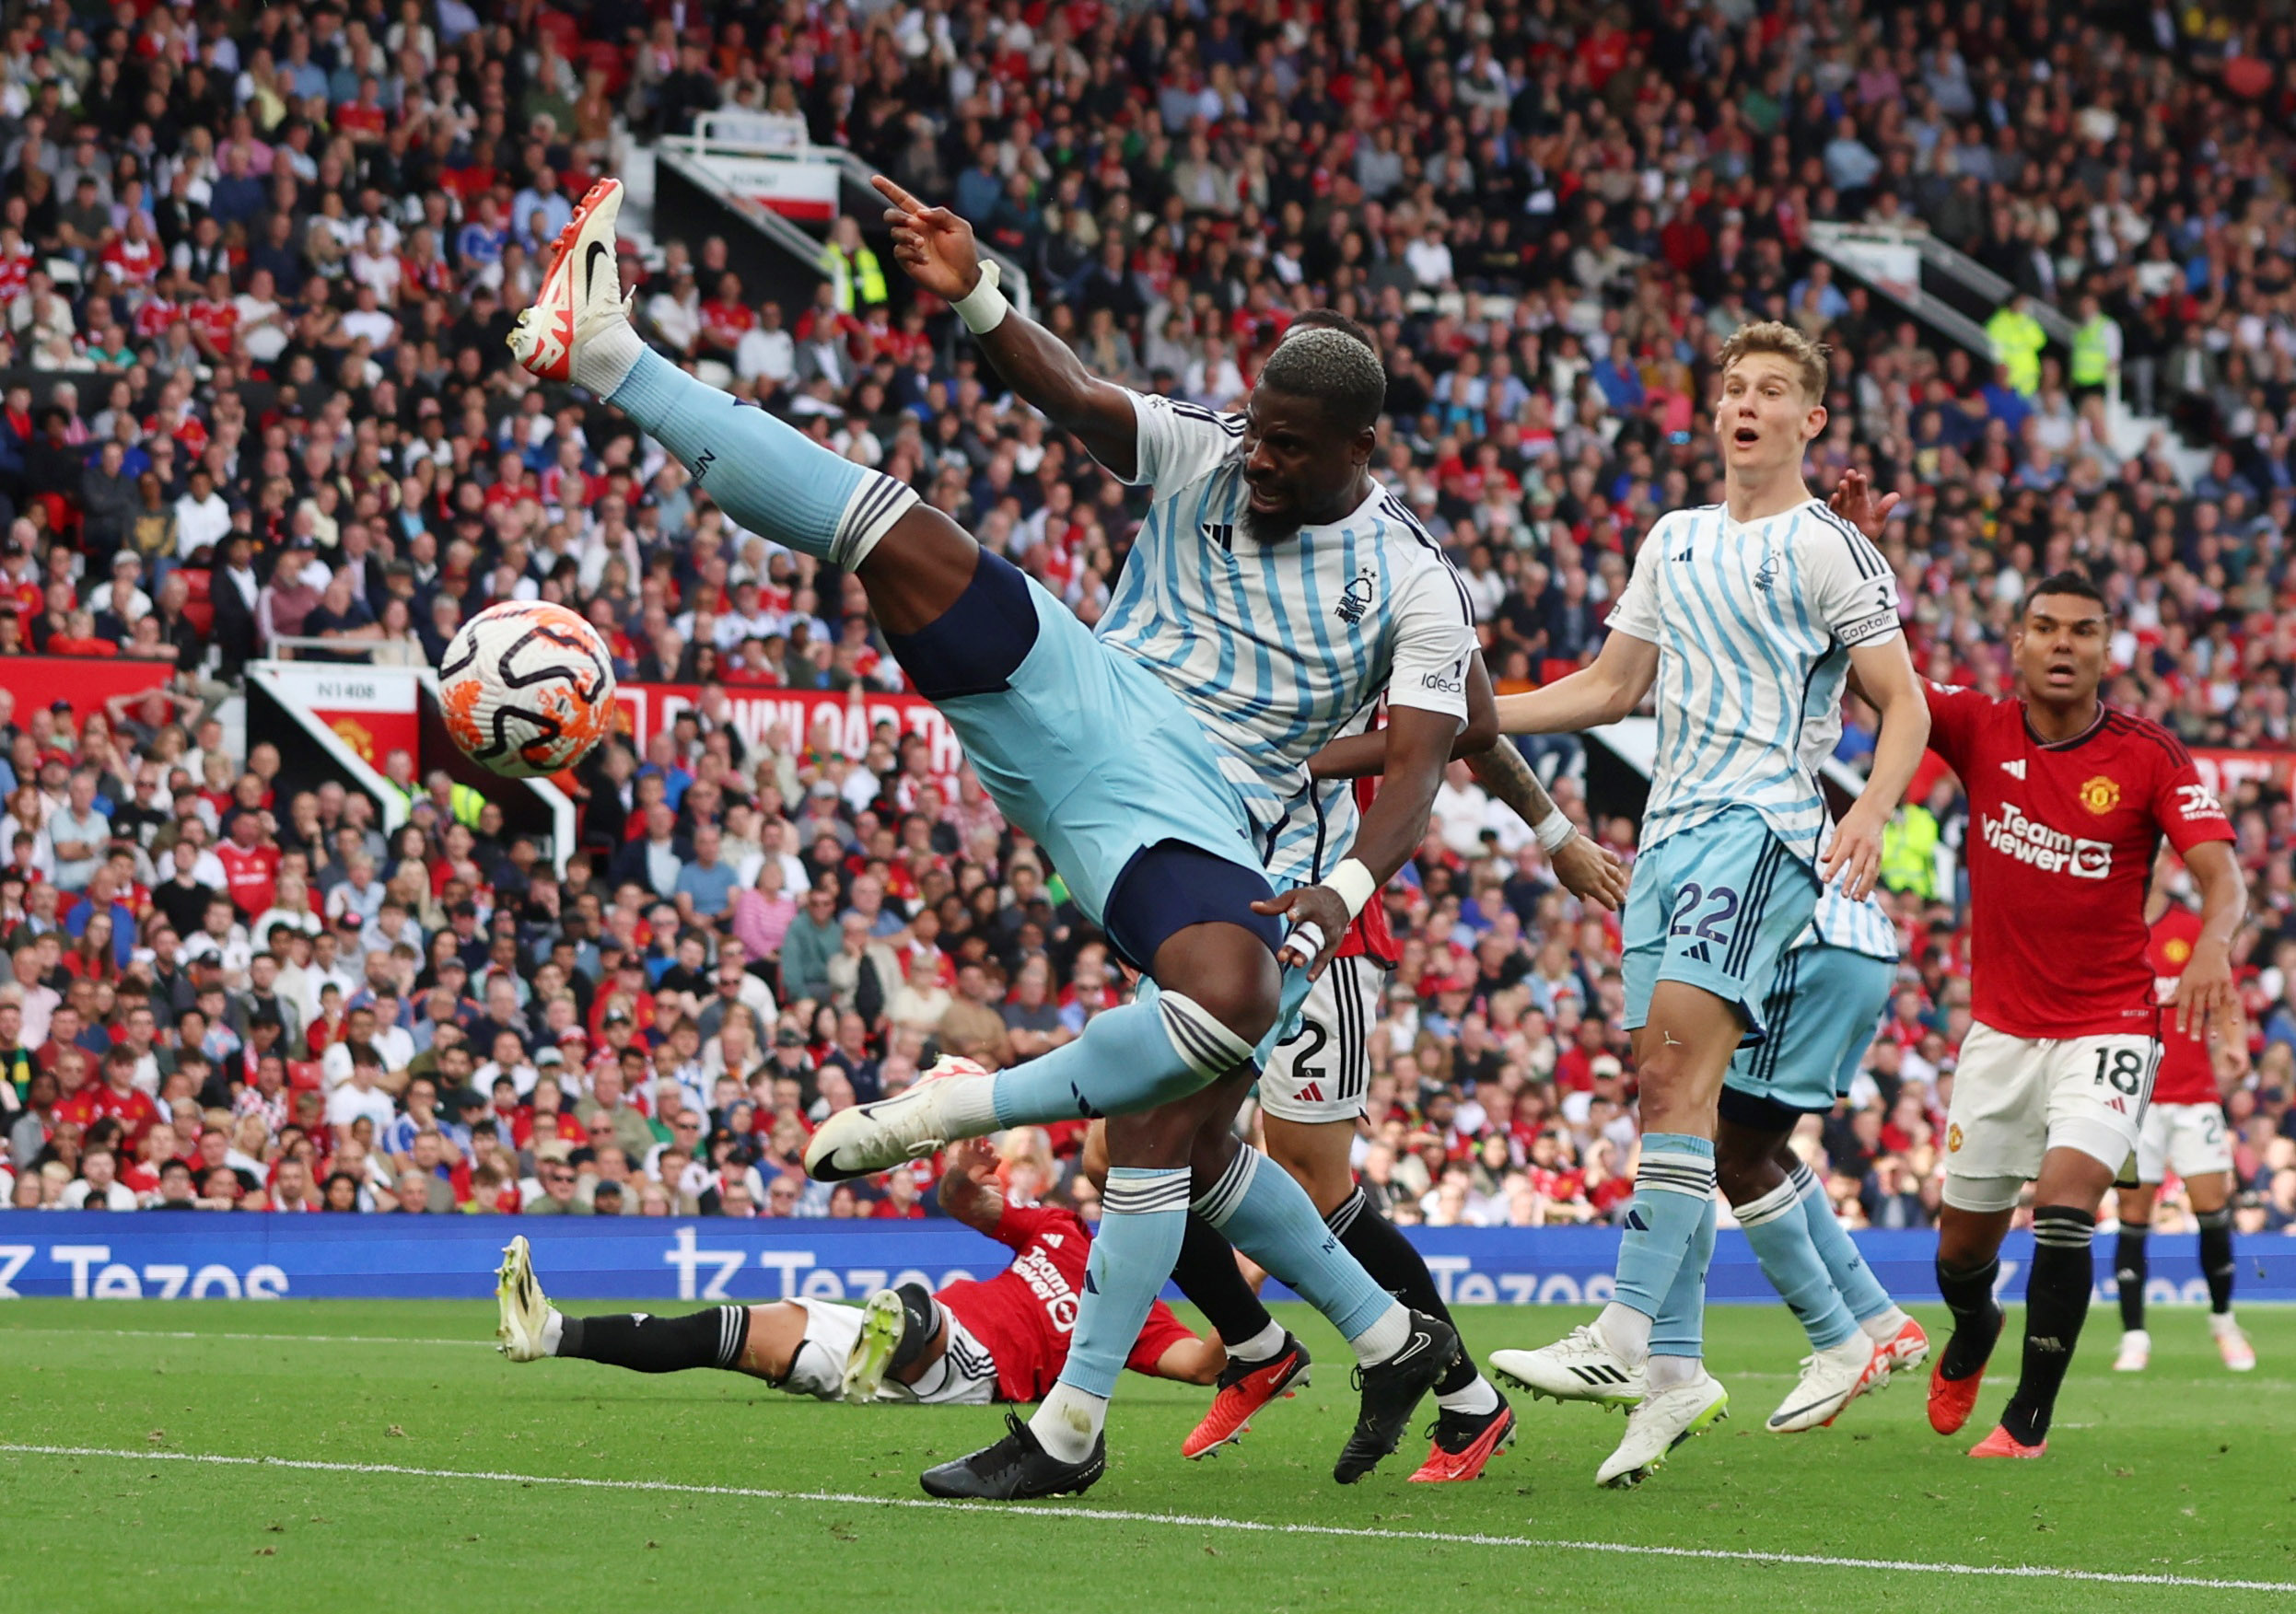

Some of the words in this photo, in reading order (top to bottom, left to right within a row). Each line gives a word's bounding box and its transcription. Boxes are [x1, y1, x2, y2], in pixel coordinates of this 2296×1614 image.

[1841, 612, 1894, 642] Captain
[662, 695, 902, 763] DWNLOAD
[2000, 801, 2073, 853] Team
[1668, 881, 1739, 946] 22
[1291, 1019, 1327, 1078] 2
[2094, 1047, 2143, 1097] 18
[50, 1244, 290, 1300] Tezos
[1024, 1245, 1071, 1296] Team
